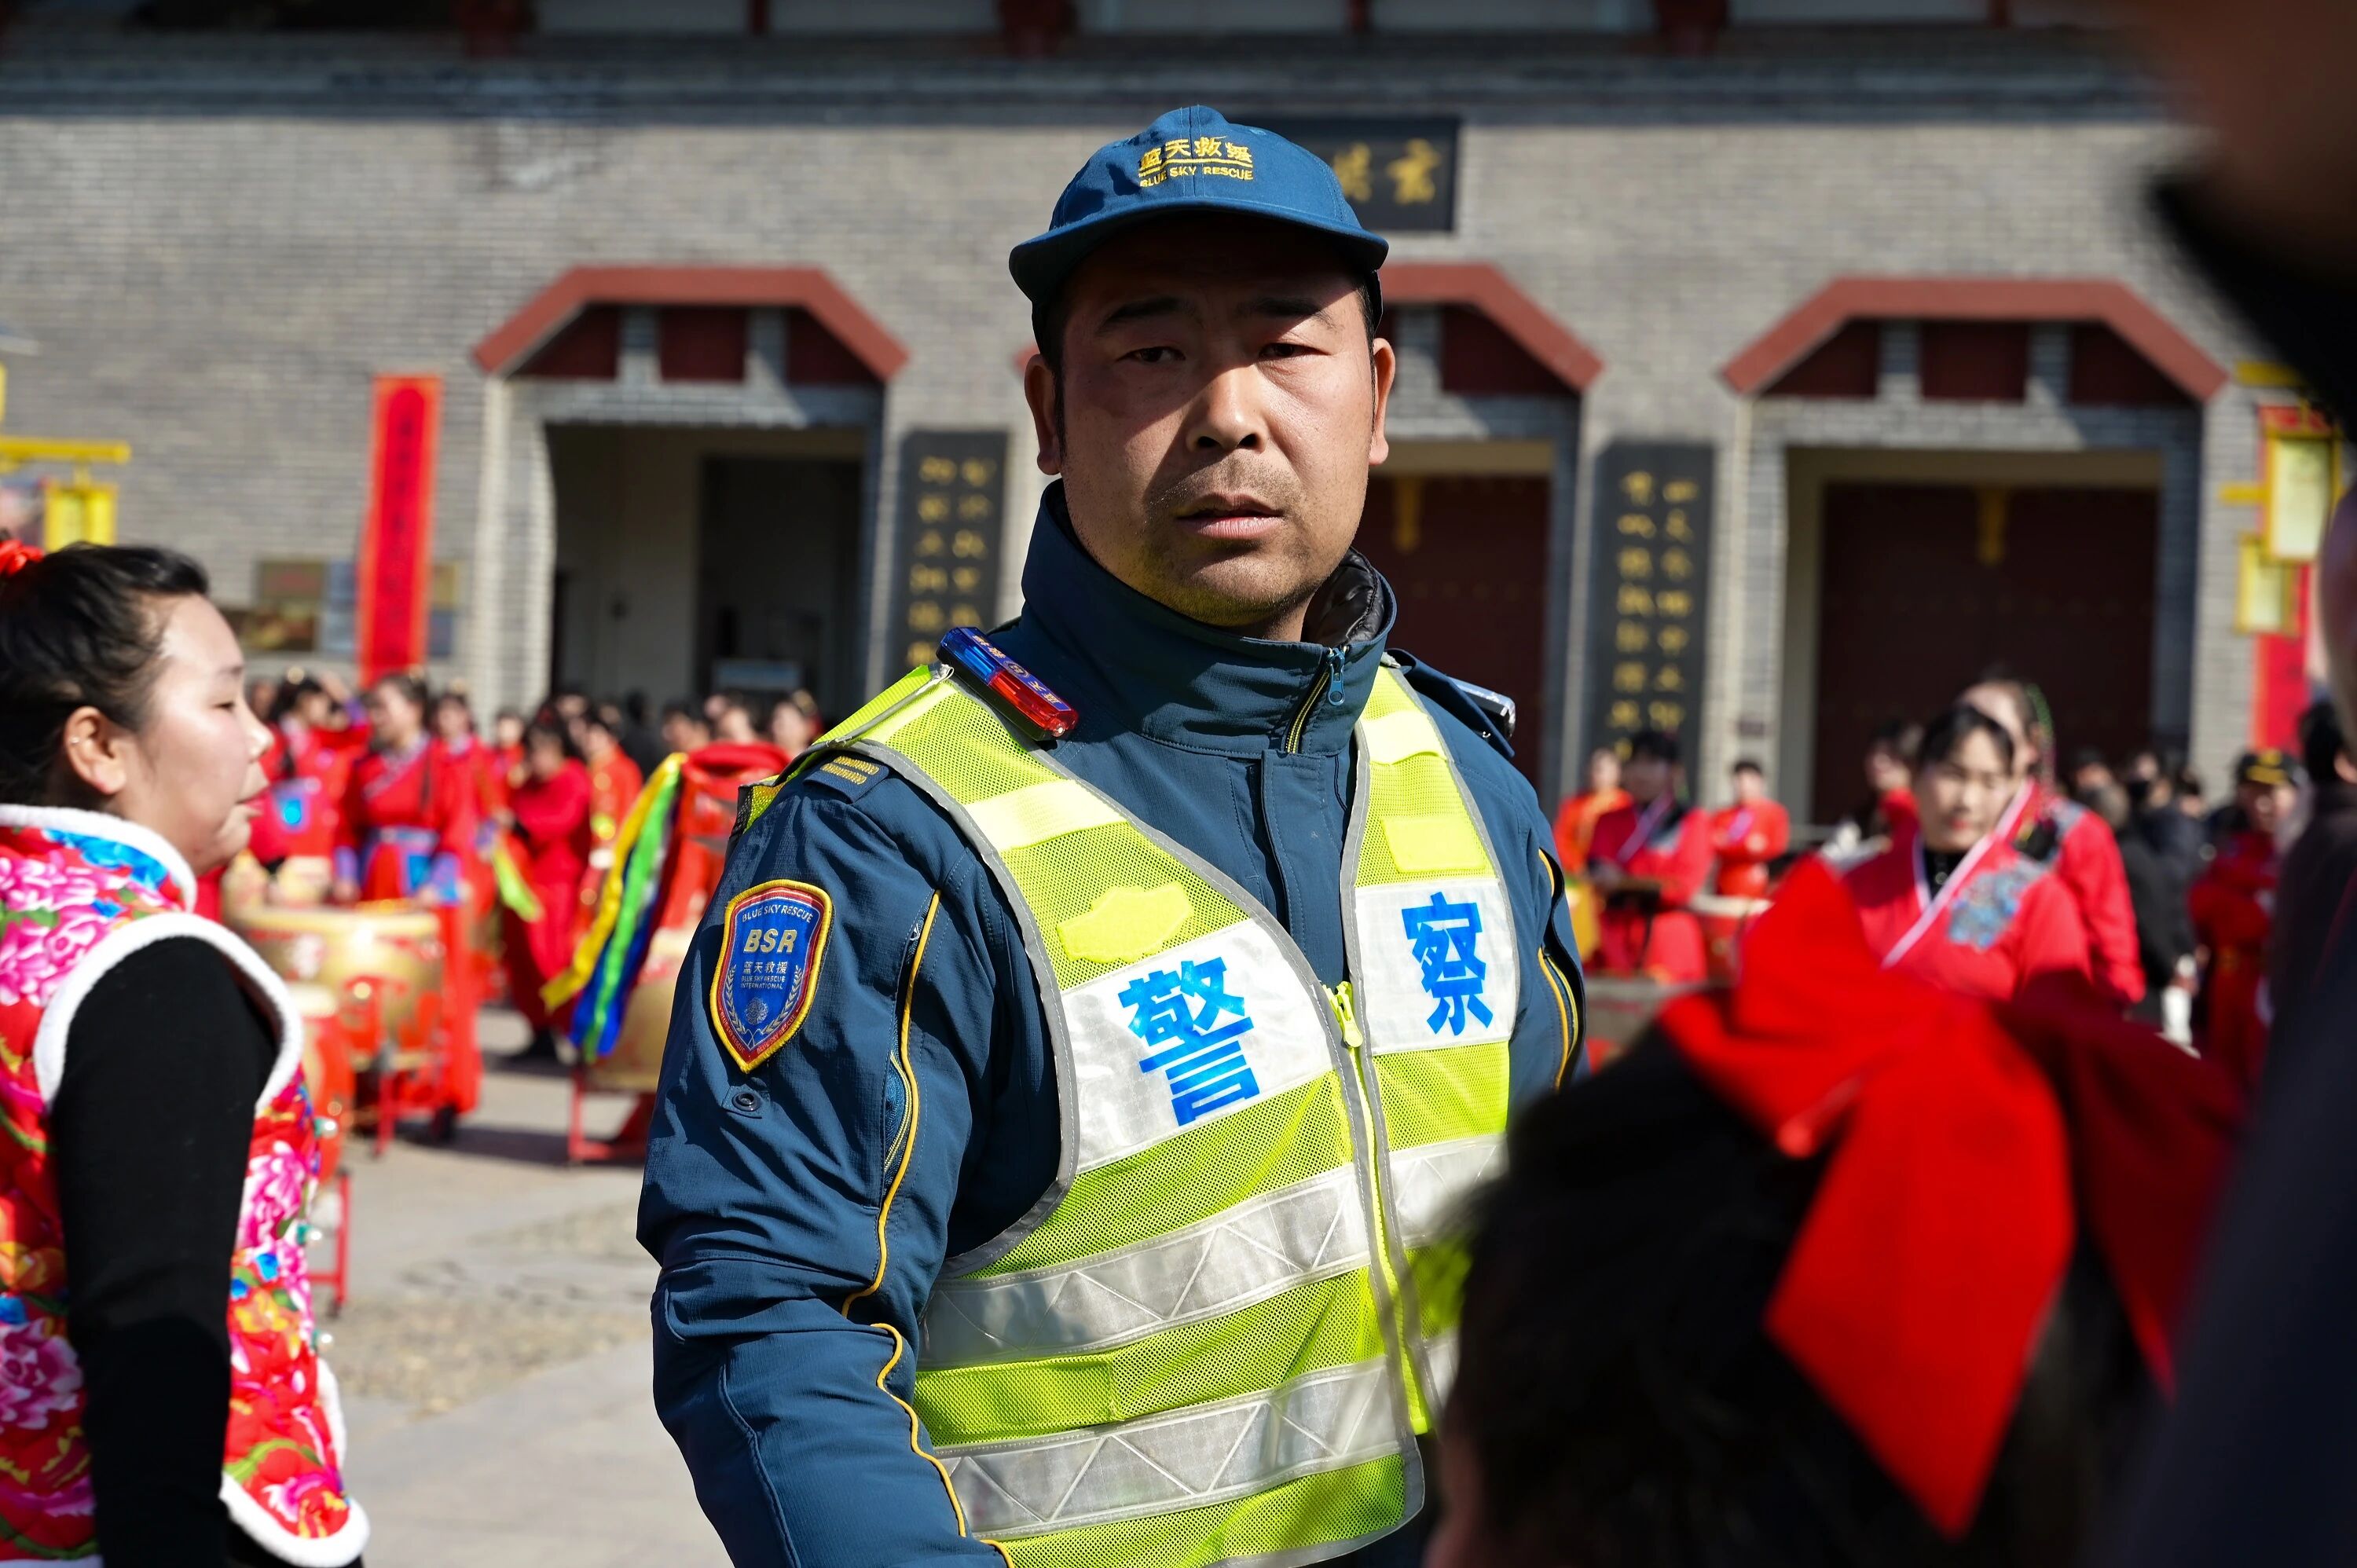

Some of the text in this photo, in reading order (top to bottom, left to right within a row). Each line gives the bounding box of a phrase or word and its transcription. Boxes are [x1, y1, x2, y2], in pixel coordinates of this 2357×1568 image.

[1139, 166, 1253, 188] BLUE SKY RESCUE
[742, 904, 813, 923] BLUE SKY RESCUE
[743, 929, 797, 953] BSR
[743, 961, 788, 974] 蓝天救援
[1118, 892, 1493, 1127] 警 察
